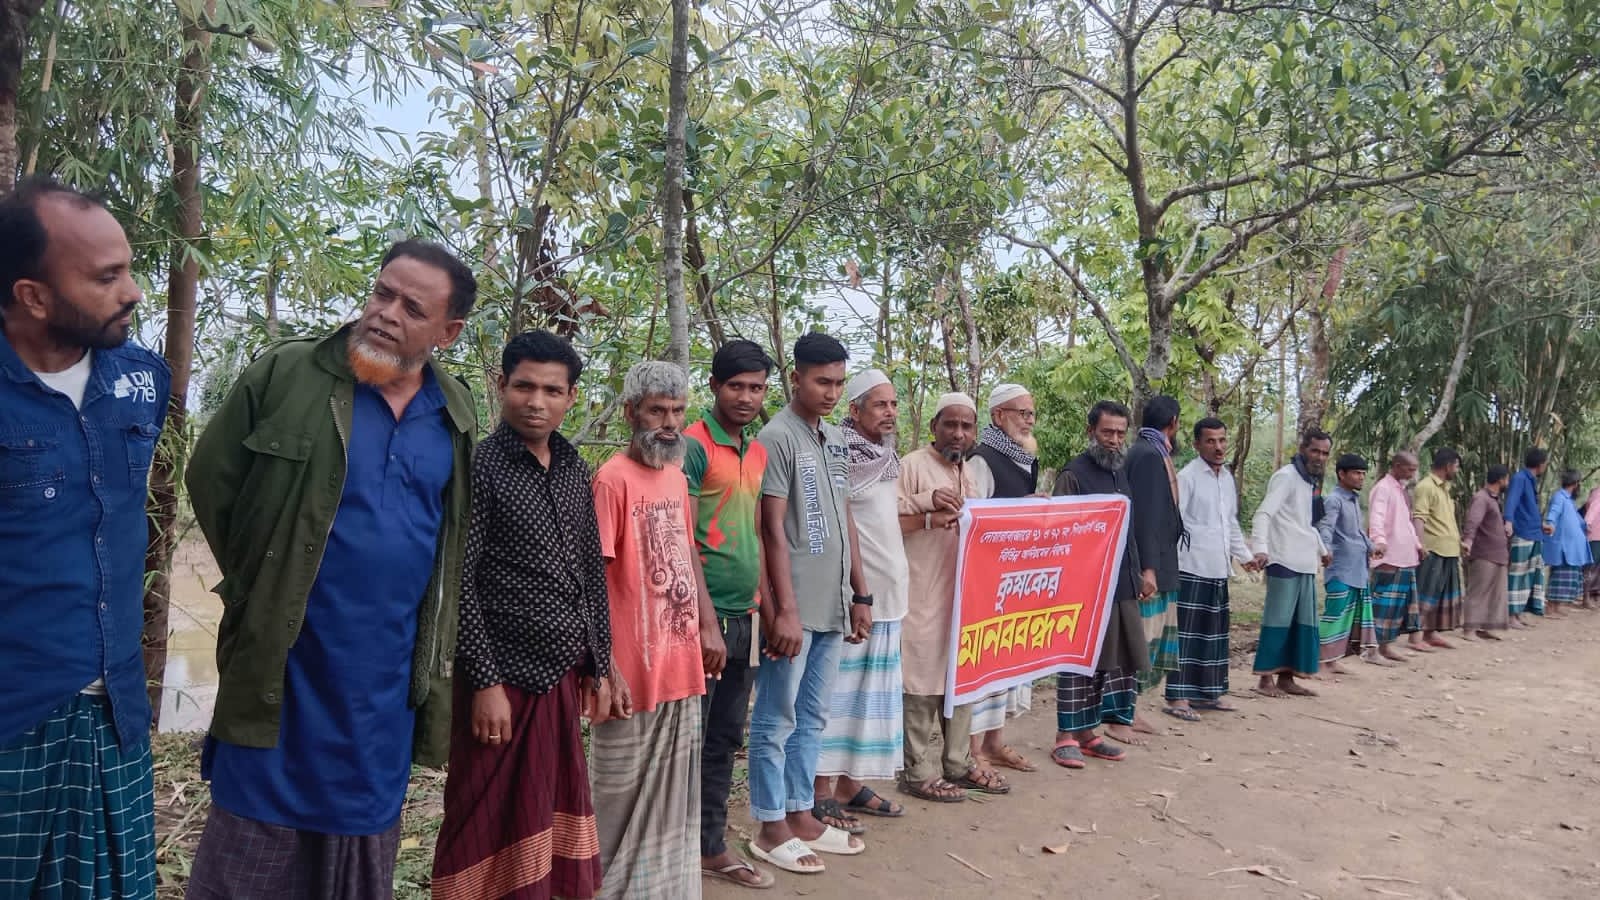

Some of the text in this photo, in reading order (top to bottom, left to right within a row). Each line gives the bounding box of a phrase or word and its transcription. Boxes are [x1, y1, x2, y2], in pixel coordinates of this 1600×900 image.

[130, 370, 154, 387] DN
[806, 509, 824, 554] LEAGUE
[994, 566, 1064, 614] কৃষকের
[957, 602, 1085, 669] মানববন্ধন
